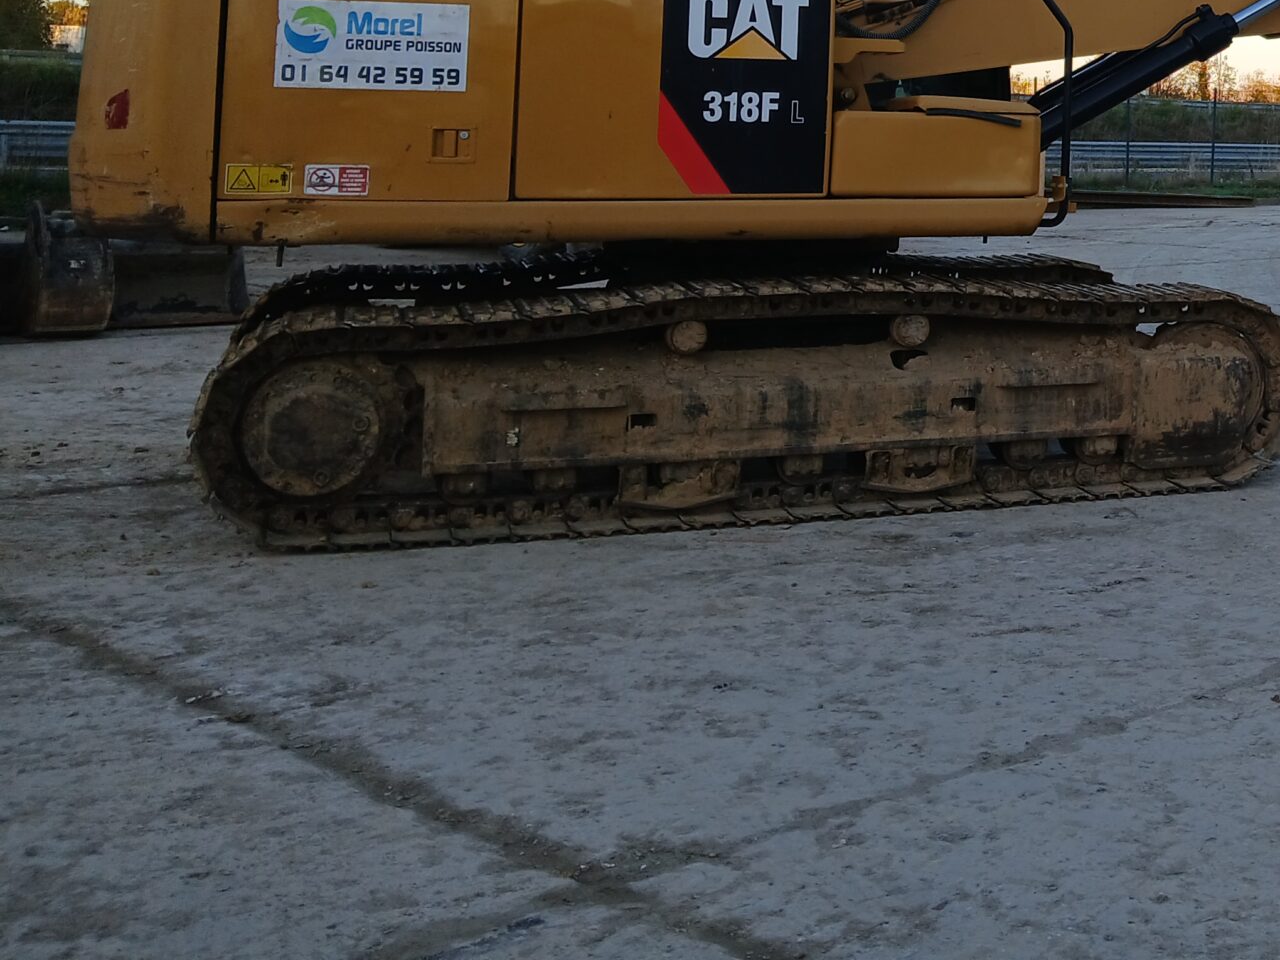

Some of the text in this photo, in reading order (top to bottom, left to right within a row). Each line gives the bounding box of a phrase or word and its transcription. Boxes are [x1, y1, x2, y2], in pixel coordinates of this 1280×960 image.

[346, 11, 422, 36] Morel
[345, 39, 462, 54] GROUPE POISSON
[280, 63, 461, 86] 01 64 42 59 59
[702, 90, 805, 124] 318F L
